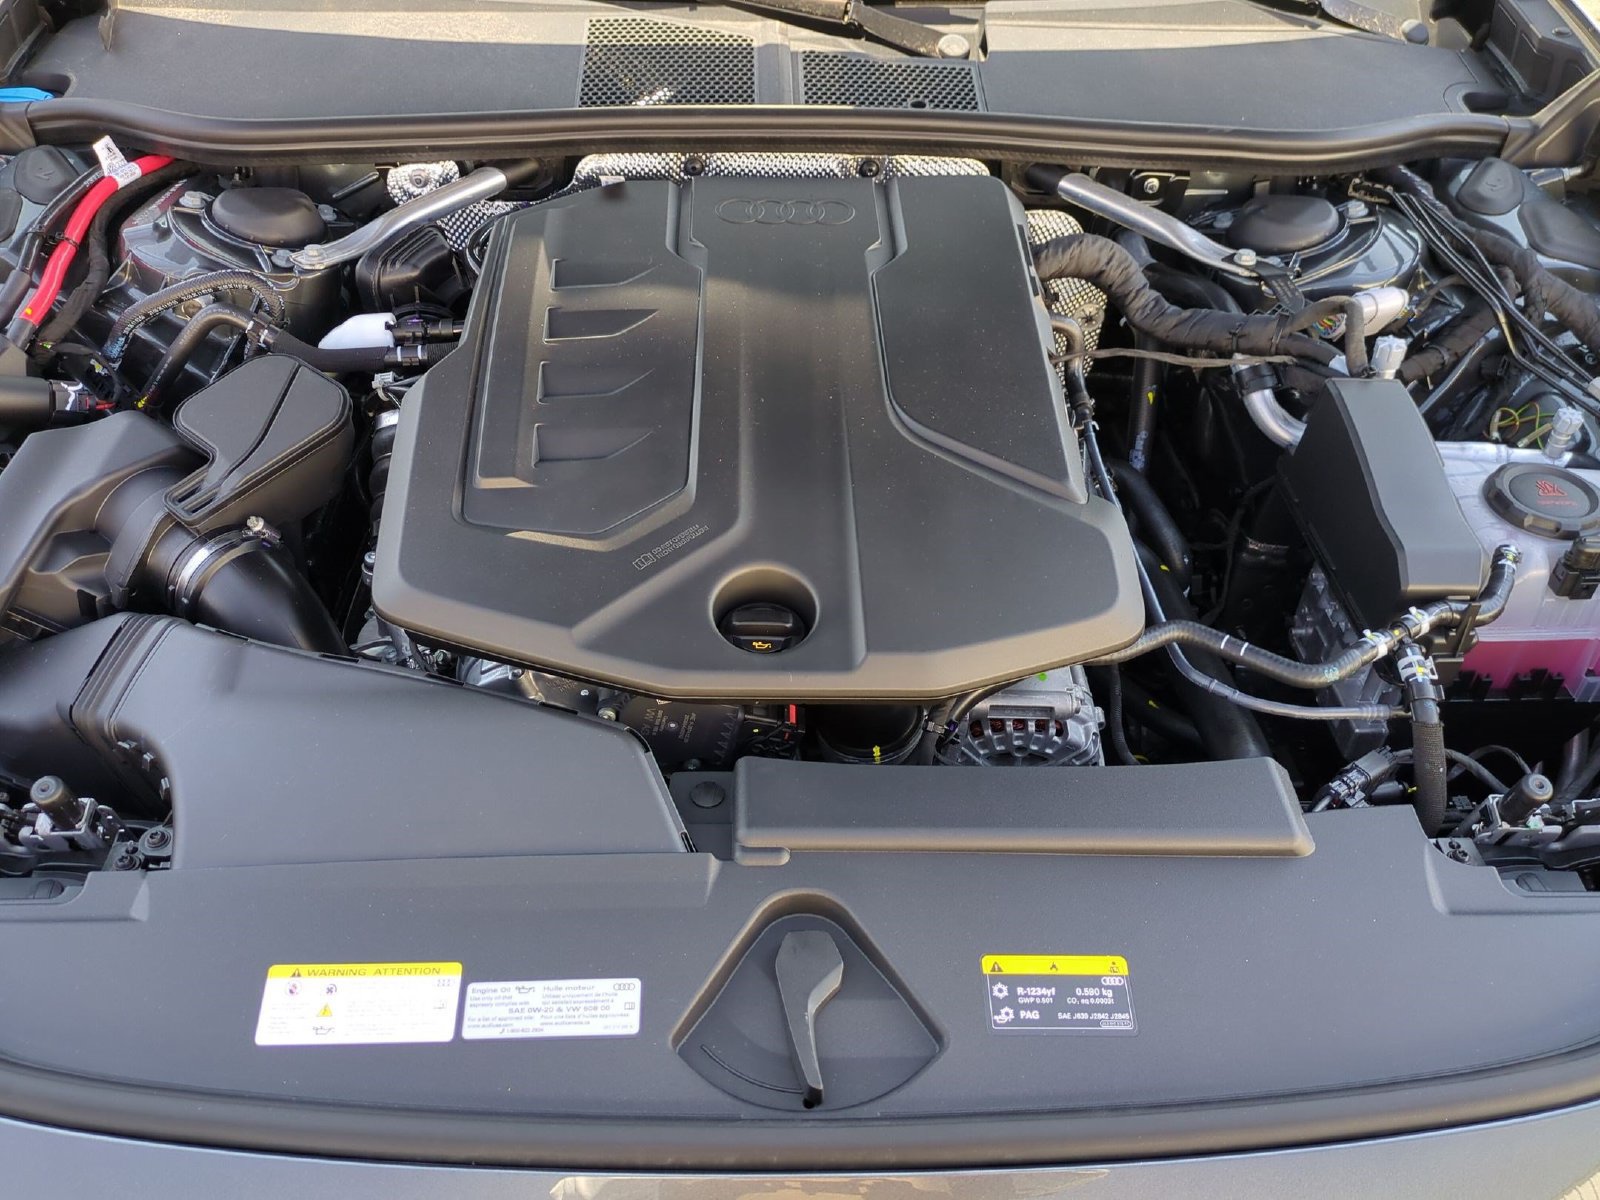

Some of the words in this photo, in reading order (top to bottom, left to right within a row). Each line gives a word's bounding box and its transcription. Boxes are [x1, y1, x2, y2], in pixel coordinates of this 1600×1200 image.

[375, 967, 441, 975] ATTENTION
[1016, 987, 1056, 997] R-1234yf
[1102, 987, 1113, 997] kg
[1020, 1011, 1040, 1019] PAG
